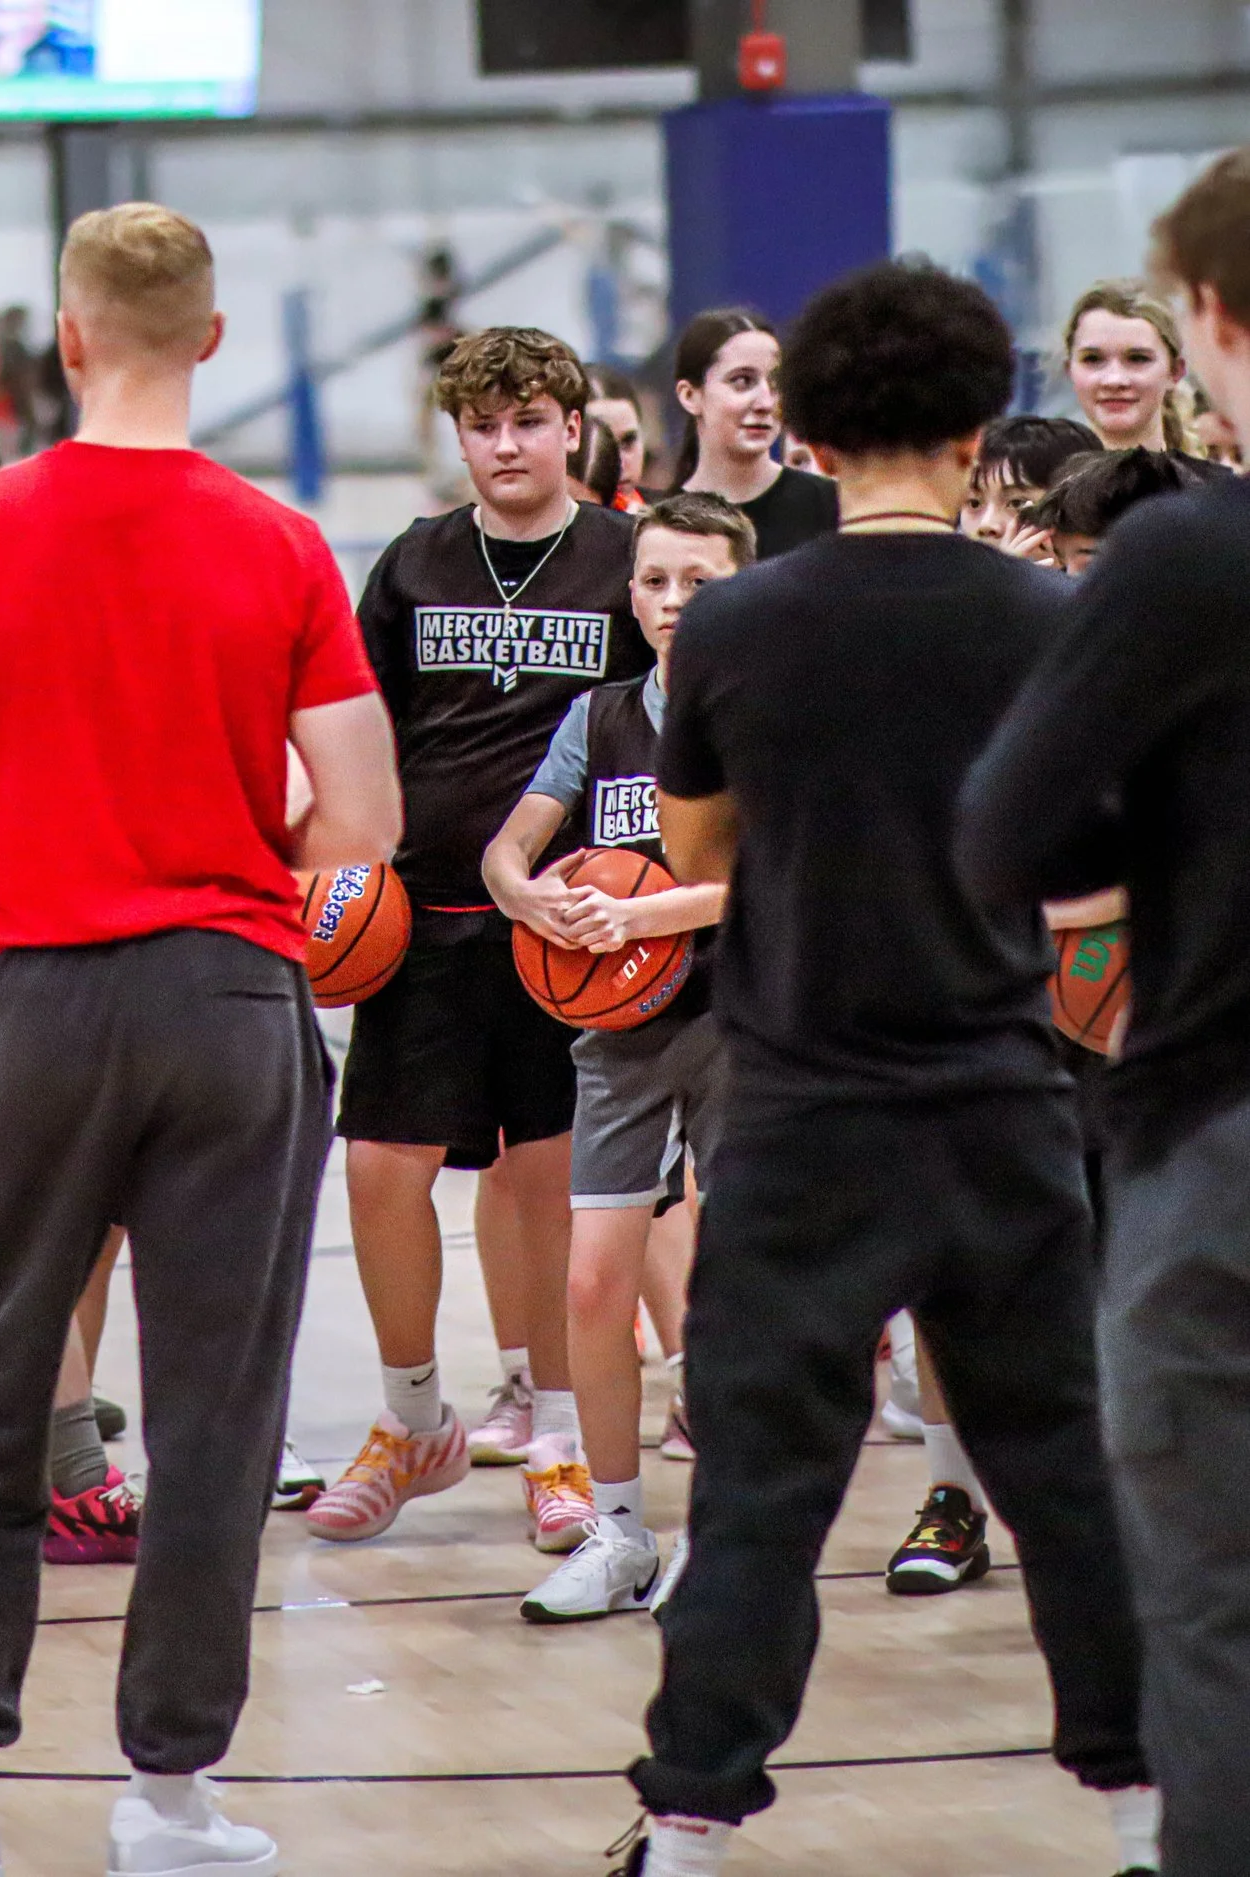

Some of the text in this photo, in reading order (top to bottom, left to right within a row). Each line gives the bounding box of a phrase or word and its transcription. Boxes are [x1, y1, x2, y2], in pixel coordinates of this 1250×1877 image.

[422, 615, 600, 644] MERCURY ELITE
[422, 638, 598, 669] BASKETBALL
